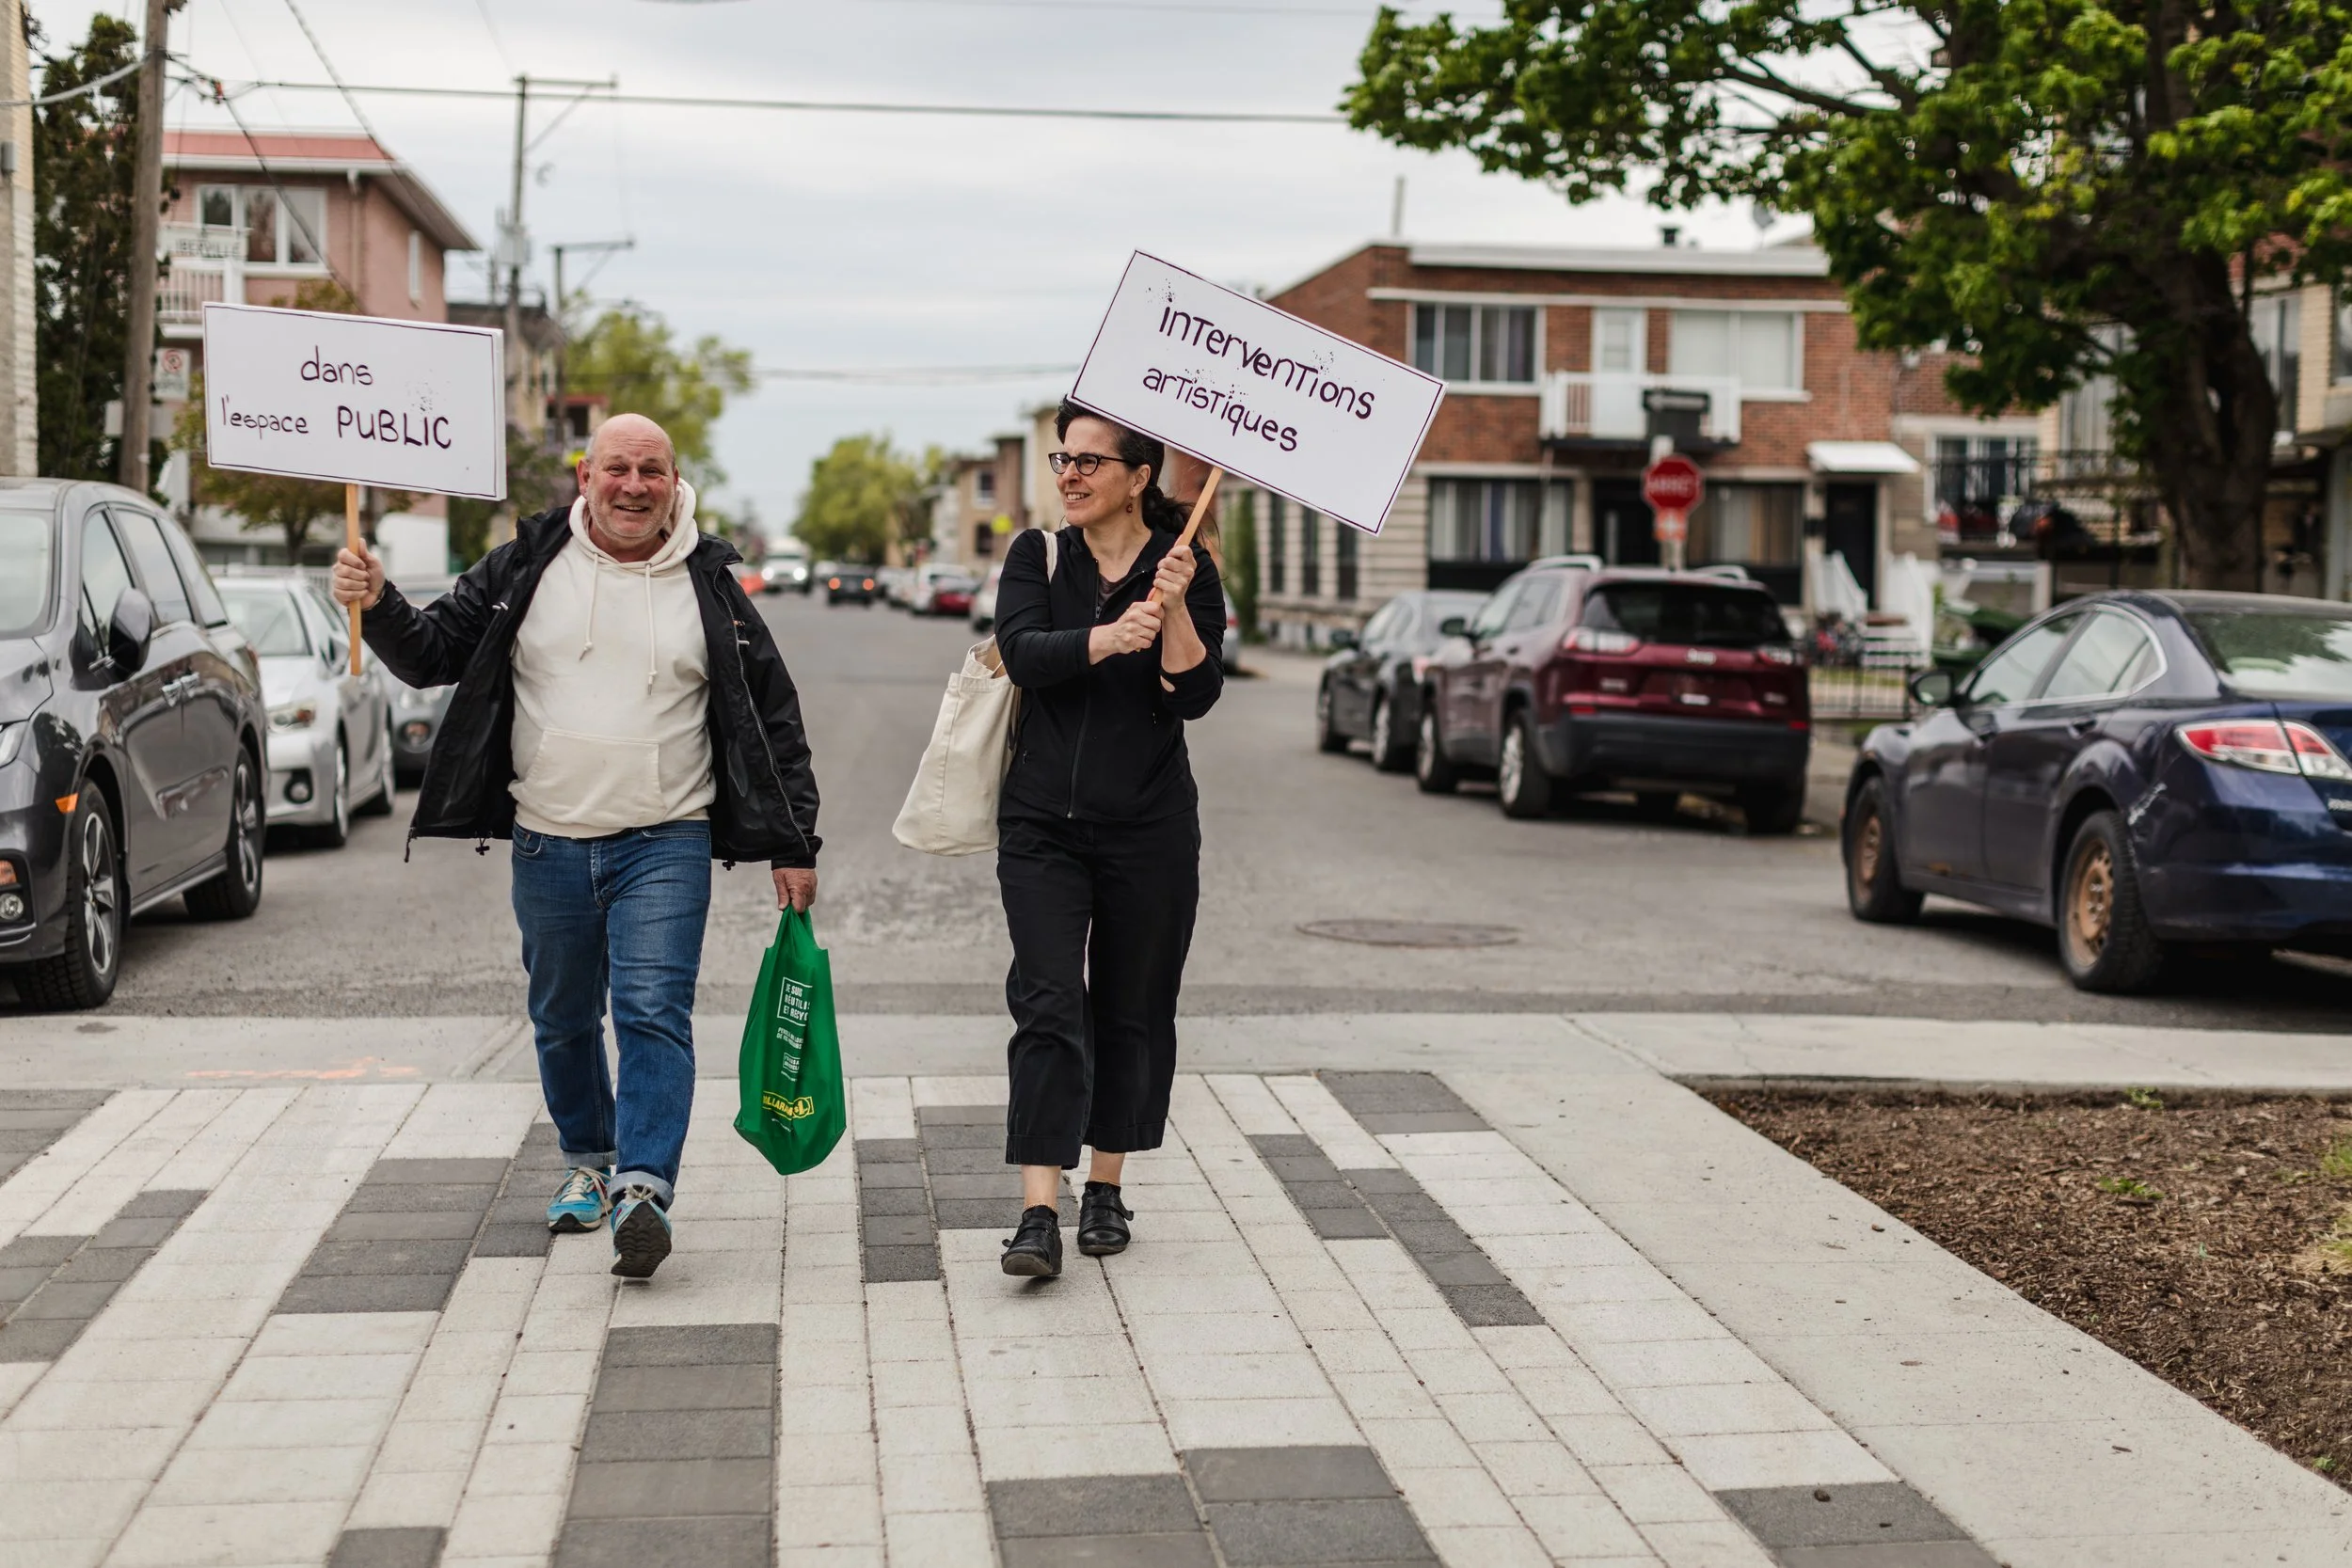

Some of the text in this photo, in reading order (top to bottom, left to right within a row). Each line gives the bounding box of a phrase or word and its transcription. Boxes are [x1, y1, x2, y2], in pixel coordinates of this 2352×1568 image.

[300, 344, 373, 386] dans
[220, 394, 453, 451] l'espace PUBLIC
[783, 1005, 790, 1015] ET
